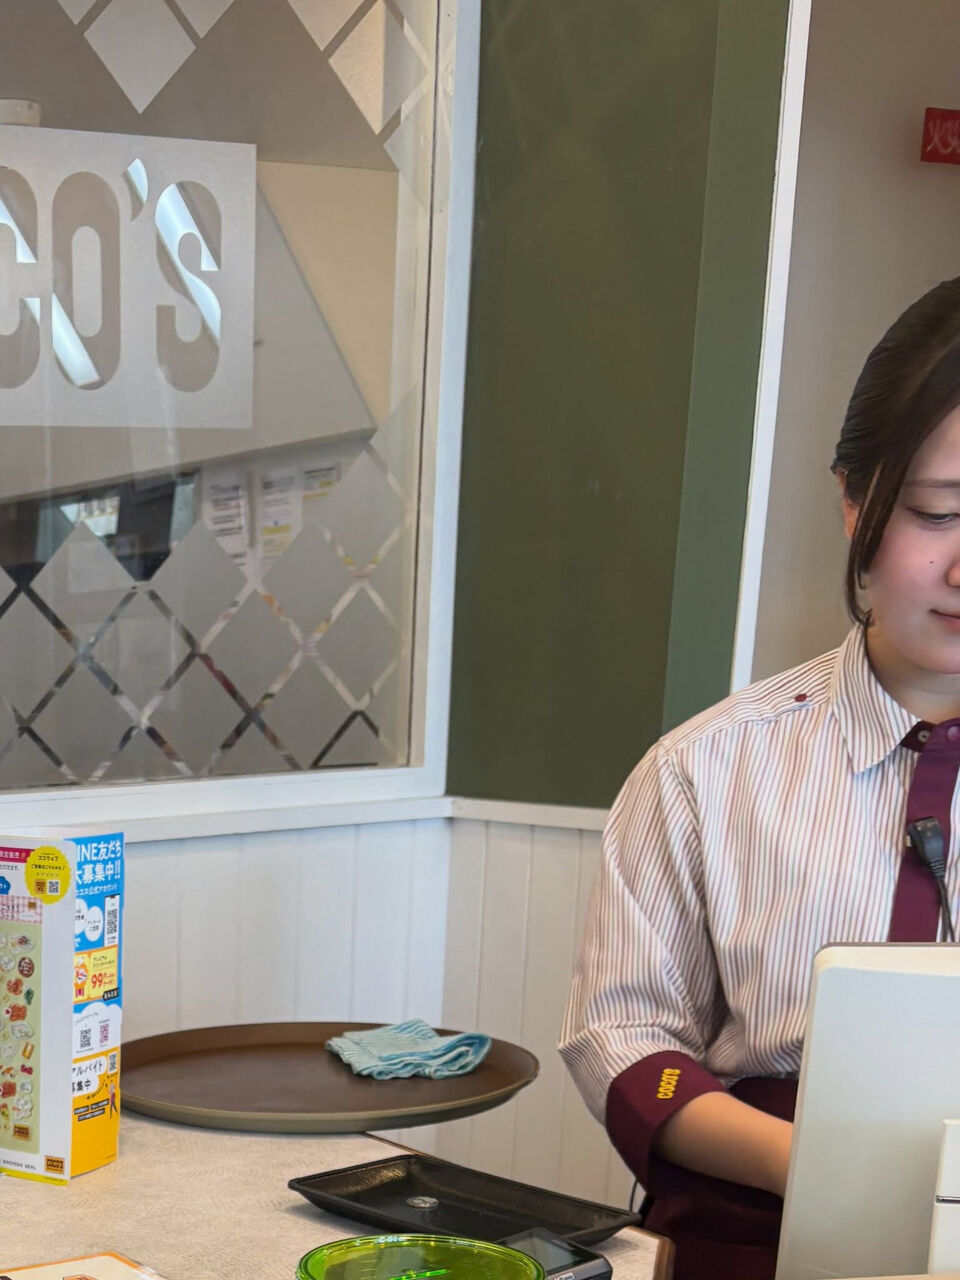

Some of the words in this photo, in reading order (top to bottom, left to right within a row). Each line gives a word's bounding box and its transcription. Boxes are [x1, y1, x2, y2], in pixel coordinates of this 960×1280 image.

[76, 840, 121, 862] INE友だち
[91, 974, 104, 989] 99
